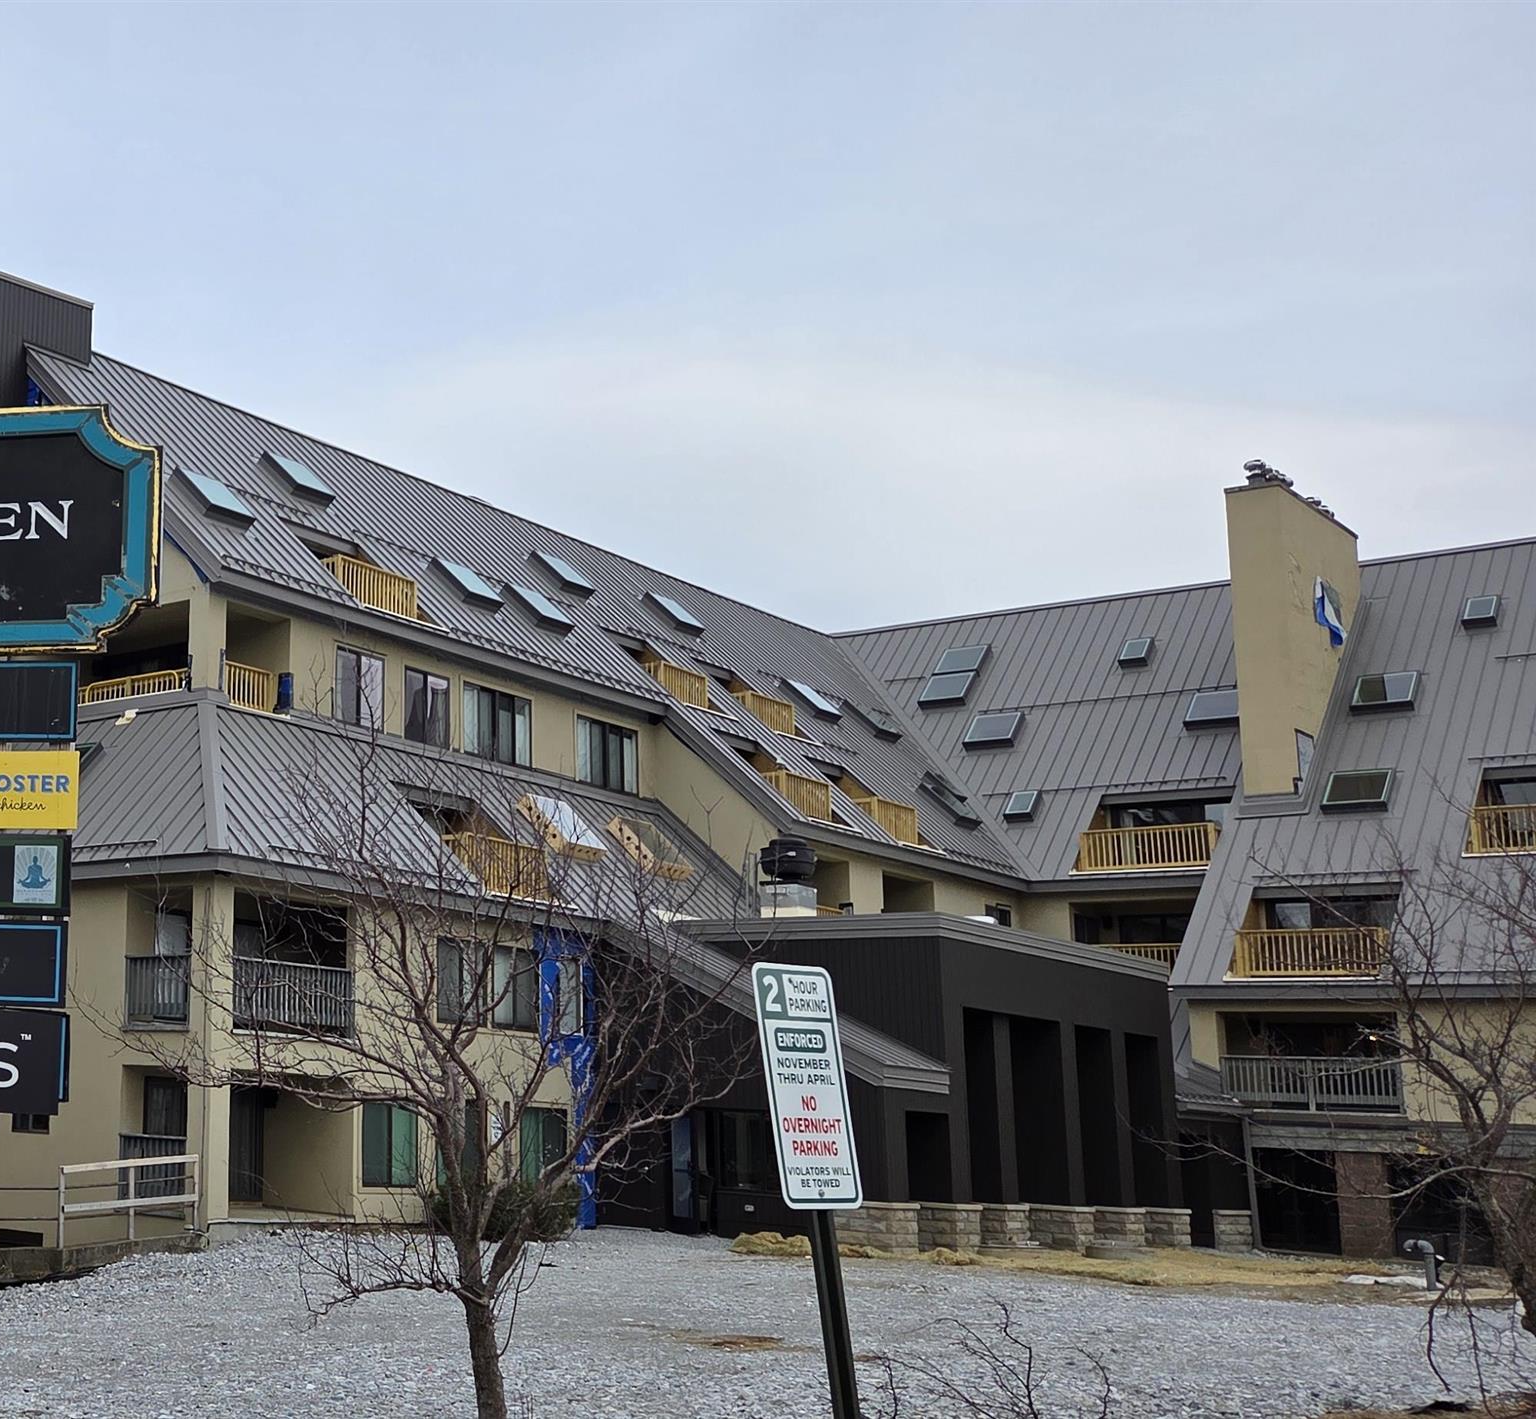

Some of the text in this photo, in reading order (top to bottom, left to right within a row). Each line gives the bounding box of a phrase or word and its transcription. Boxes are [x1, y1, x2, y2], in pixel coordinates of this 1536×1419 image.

[762, 975, 782, 1012] 2
[792, 981, 818, 995] HOUR
[789, 999, 827, 1014] PARKING
[777, 1032, 824, 1049] ENFORCED
[777, 1057, 832, 1070] NOVEMBER
[777, 1073, 835, 1086] THRU APRIL
[801, 1095, 817, 1112] NO
[782, 1117, 842, 1134] OVERNIGHT
[792, 1140, 839, 1156] PARKING
[787, 1166, 851, 1176] VIOLATORS WILL
[801, 1179, 841, 1188] BE TOWED
